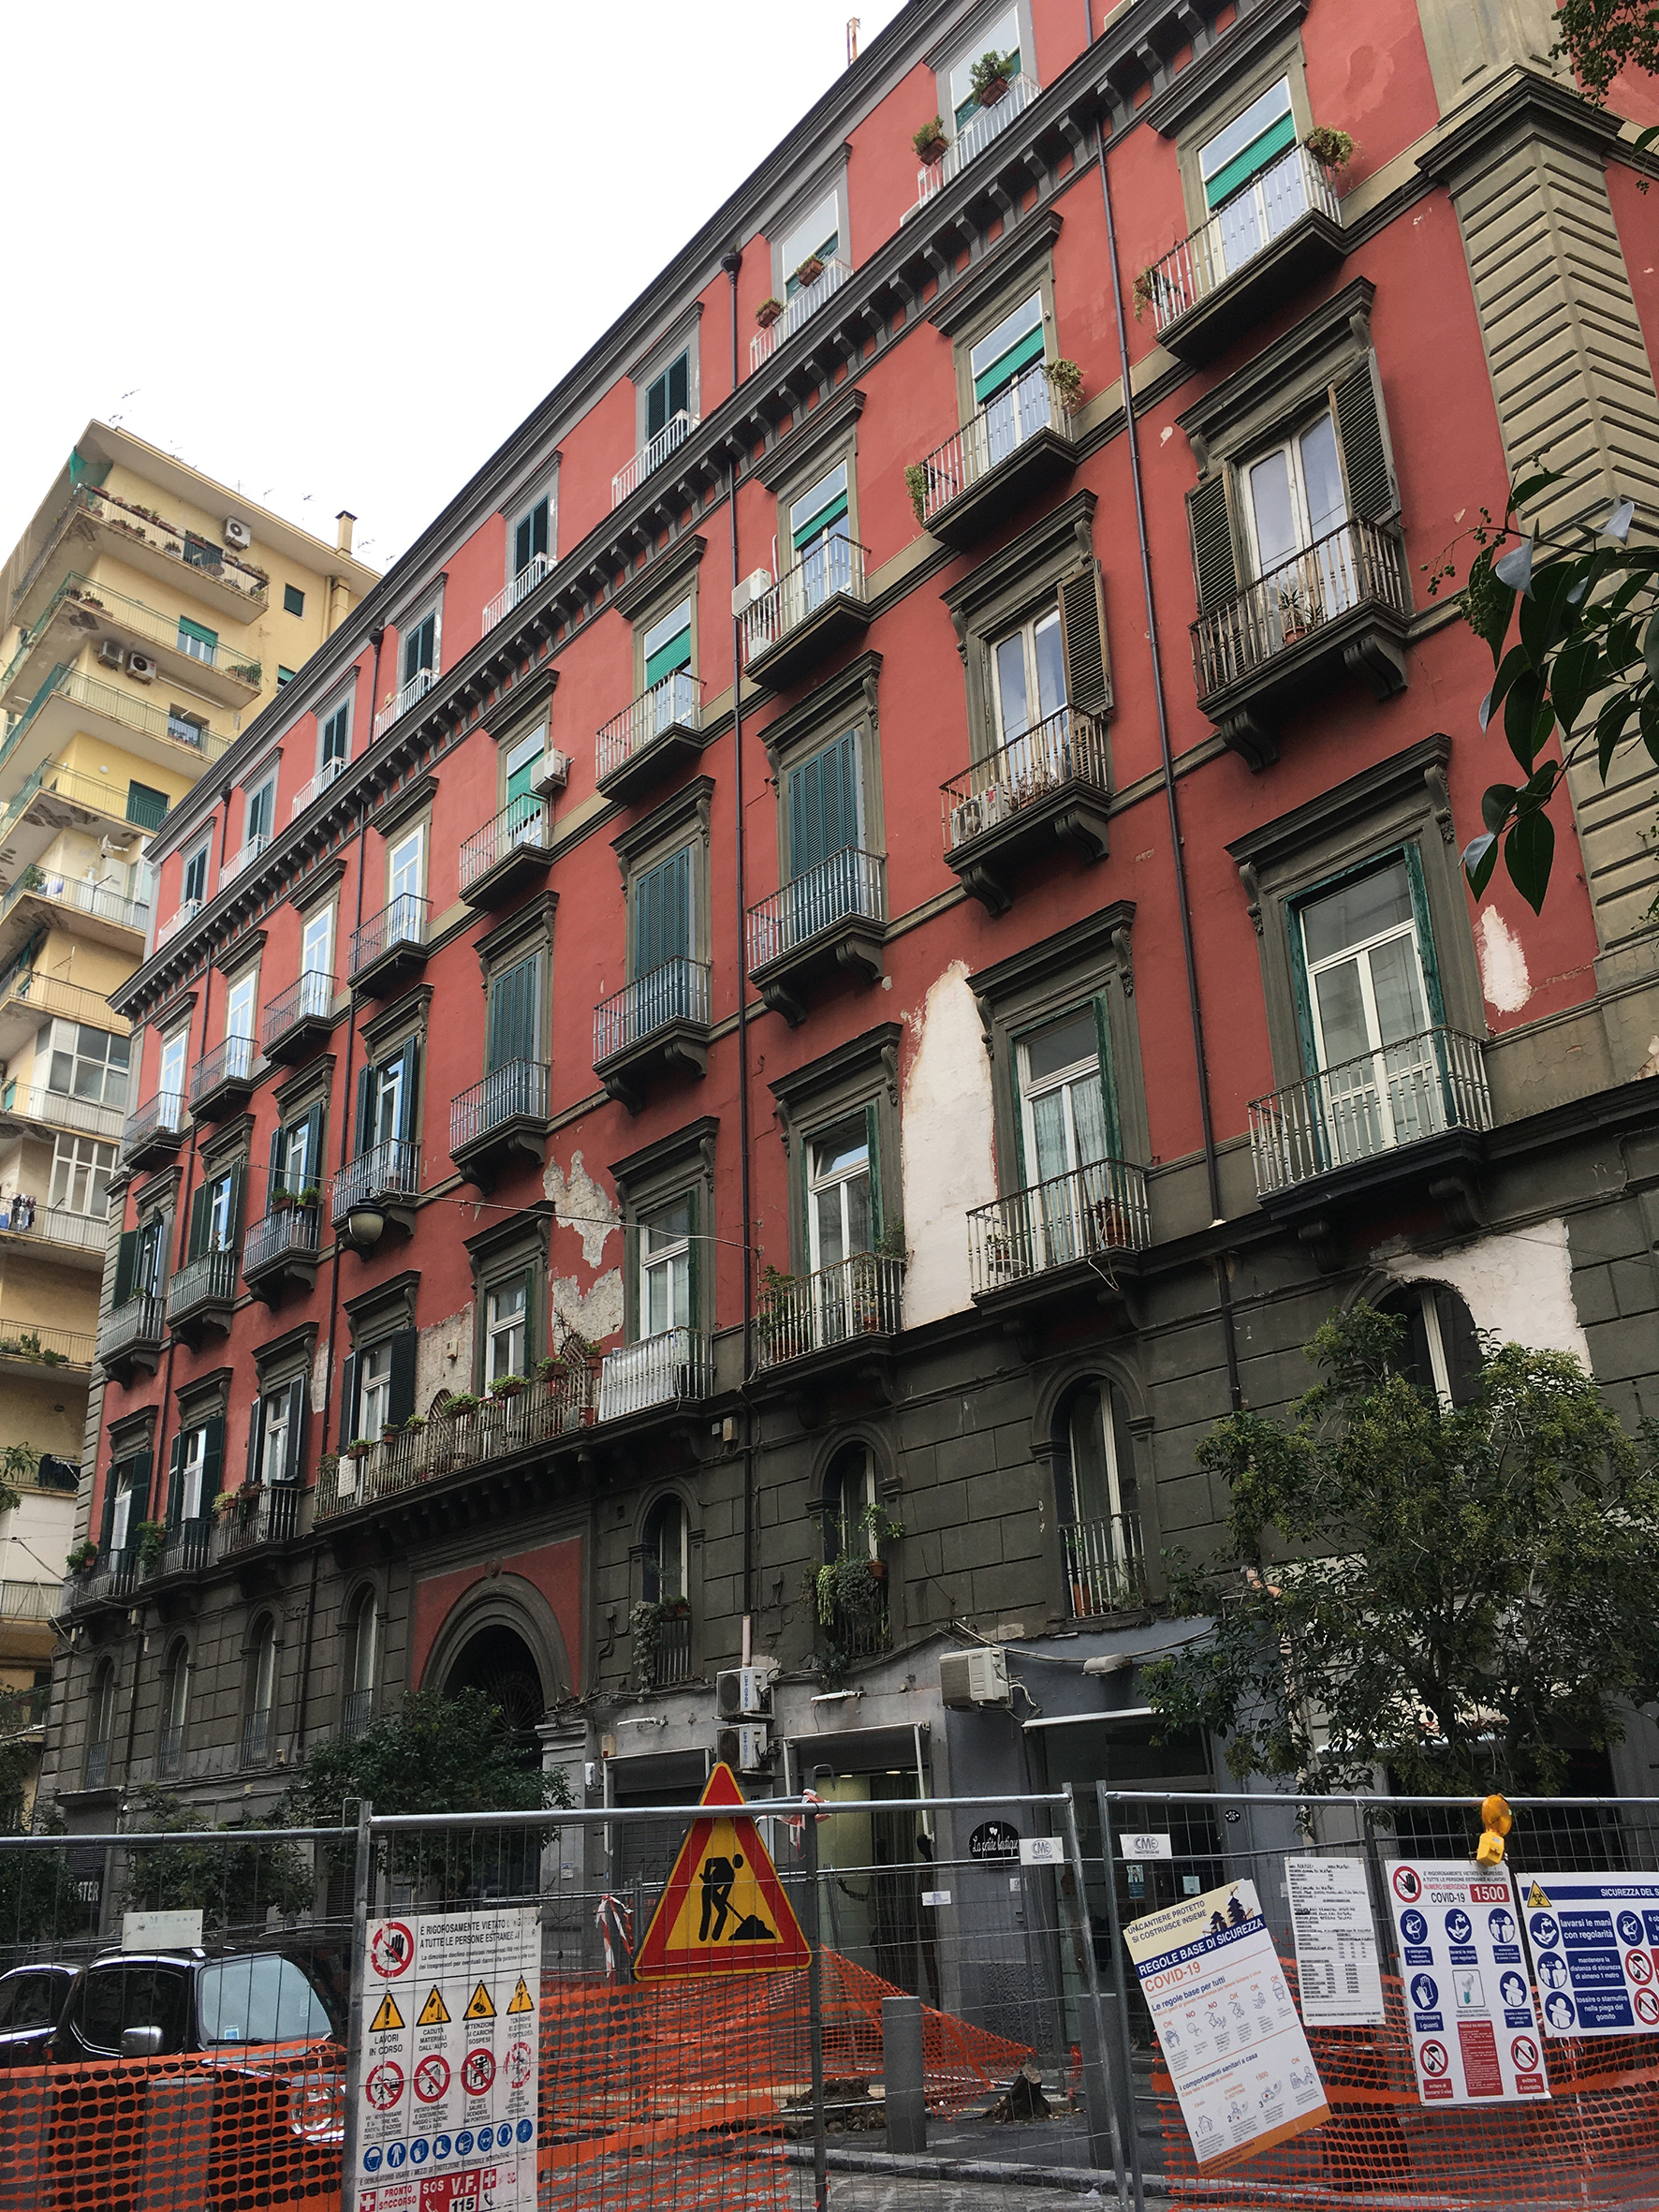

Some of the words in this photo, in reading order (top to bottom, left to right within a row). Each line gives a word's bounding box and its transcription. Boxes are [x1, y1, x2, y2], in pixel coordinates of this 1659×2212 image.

[1033, 1841, 1050, 1854] CME
[1135, 1836, 1156, 1851] CME
[1431, 1892, 1465, 1903] COVID-19
[1474, 1886, 1505, 1901] 1500
[1601, 1888, 1639, 1896] SICUREZZA
[1138, 1912, 1171, 1931] CANTIERE
[1171, 1899, 1206, 1919] PROTETTO
[481, 1919, 506, 1930] VIETATO
[1132, 1935, 1139, 1943] SI
[1140, 1920, 1182, 1940] COSTRUISCE
[1182, 1910, 1208, 1925] INSIEME
[1560, 1919, 1584, 1927] lavarsi
[1593, 1918, 1611, 1926] mani
[1579, 1929, 1613, 1940] regolarità
[425, 1938, 444, 1948] TUTTE
[446, 1937, 453, 1946] LE
[454, 1934, 483, 1945] PERSONE
[1138, 1953, 1180, 1976] REGOLE
[1179, 1942, 1206, 1960] BASE
[1206, 1937, 1216, 1949] DI
[1216, 1918, 1264, 1945] SICUREZZA
[1145, 1961, 1201, 1993] COVID-19
[1270, 1974, 1279, 1983] OK
[1250, 1983, 1259, 1992] OK
[1152, 2003, 1161, 2012] Le
[1162, 1995, 1183, 2008] regole
[1183, 1986, 1200, 1999] base
[1200, 1982, 1211, 1994] per
[1211, 1975, 1226, 1986] tutti
[1208, 2001, 1218, 2010] NO
[1185, 2011, 1196, 2019] NO
[464, 2020, 495, 2030] ATTENZIONE
[1163, 2020, 1173, 2028] OK
[423, 2028, 444, 2036] CADUTA
[473, 2028, 494, 2037] CARICHI
[375, 2033, 399, 2044] LAVORI
[420, 2035, 448, 2044] MATERIALI
[468, 2036, 491, 2044] SOSPESI
[369, 2045, 376, 2057] IN
[378, 2044, 404, 2055] CORSO
[1291, 2057, 1300, 2065] OK
[422, 2180, 445, 2194] SOS
[450, 2175, 477, 2195] V.F.
[385, 2185, 412, 2198] PRONTO
[379, 2195, 417, 2210] SOCCORSO
[451, 2197, 475, 2212] 115
